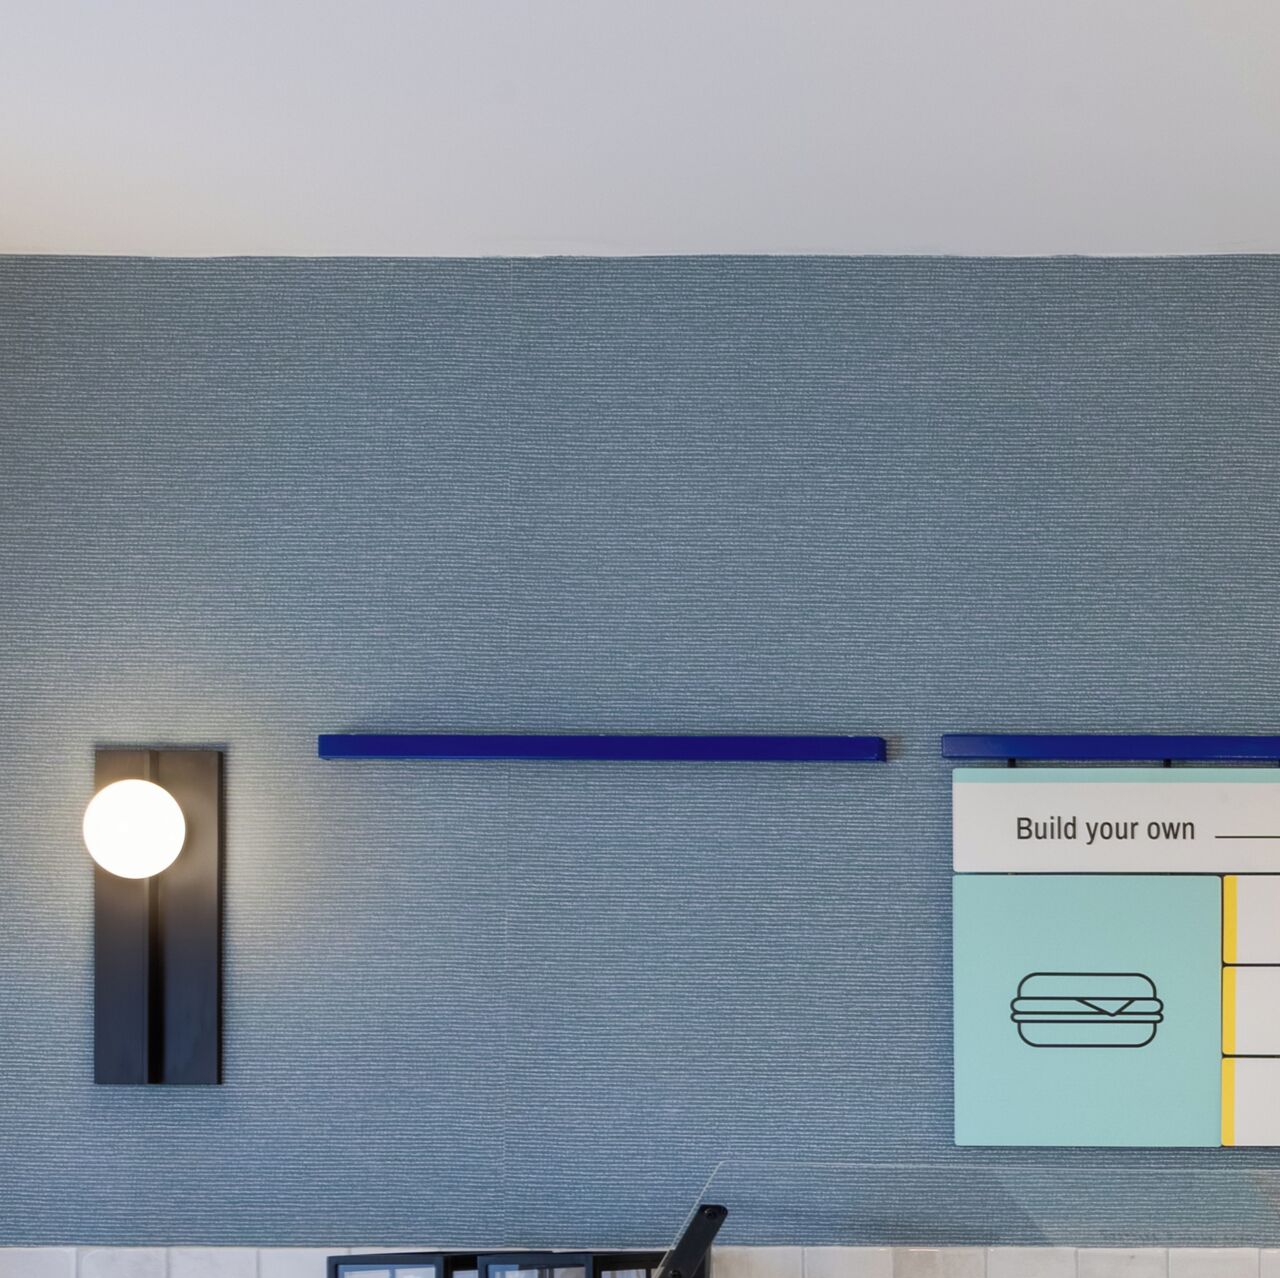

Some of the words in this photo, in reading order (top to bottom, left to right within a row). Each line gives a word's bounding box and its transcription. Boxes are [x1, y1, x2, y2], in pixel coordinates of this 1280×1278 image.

[1016, 815, 1077, 840] Build
[1085, 821, 1139, 846] your
[1147, 821, 1195, 840] own
